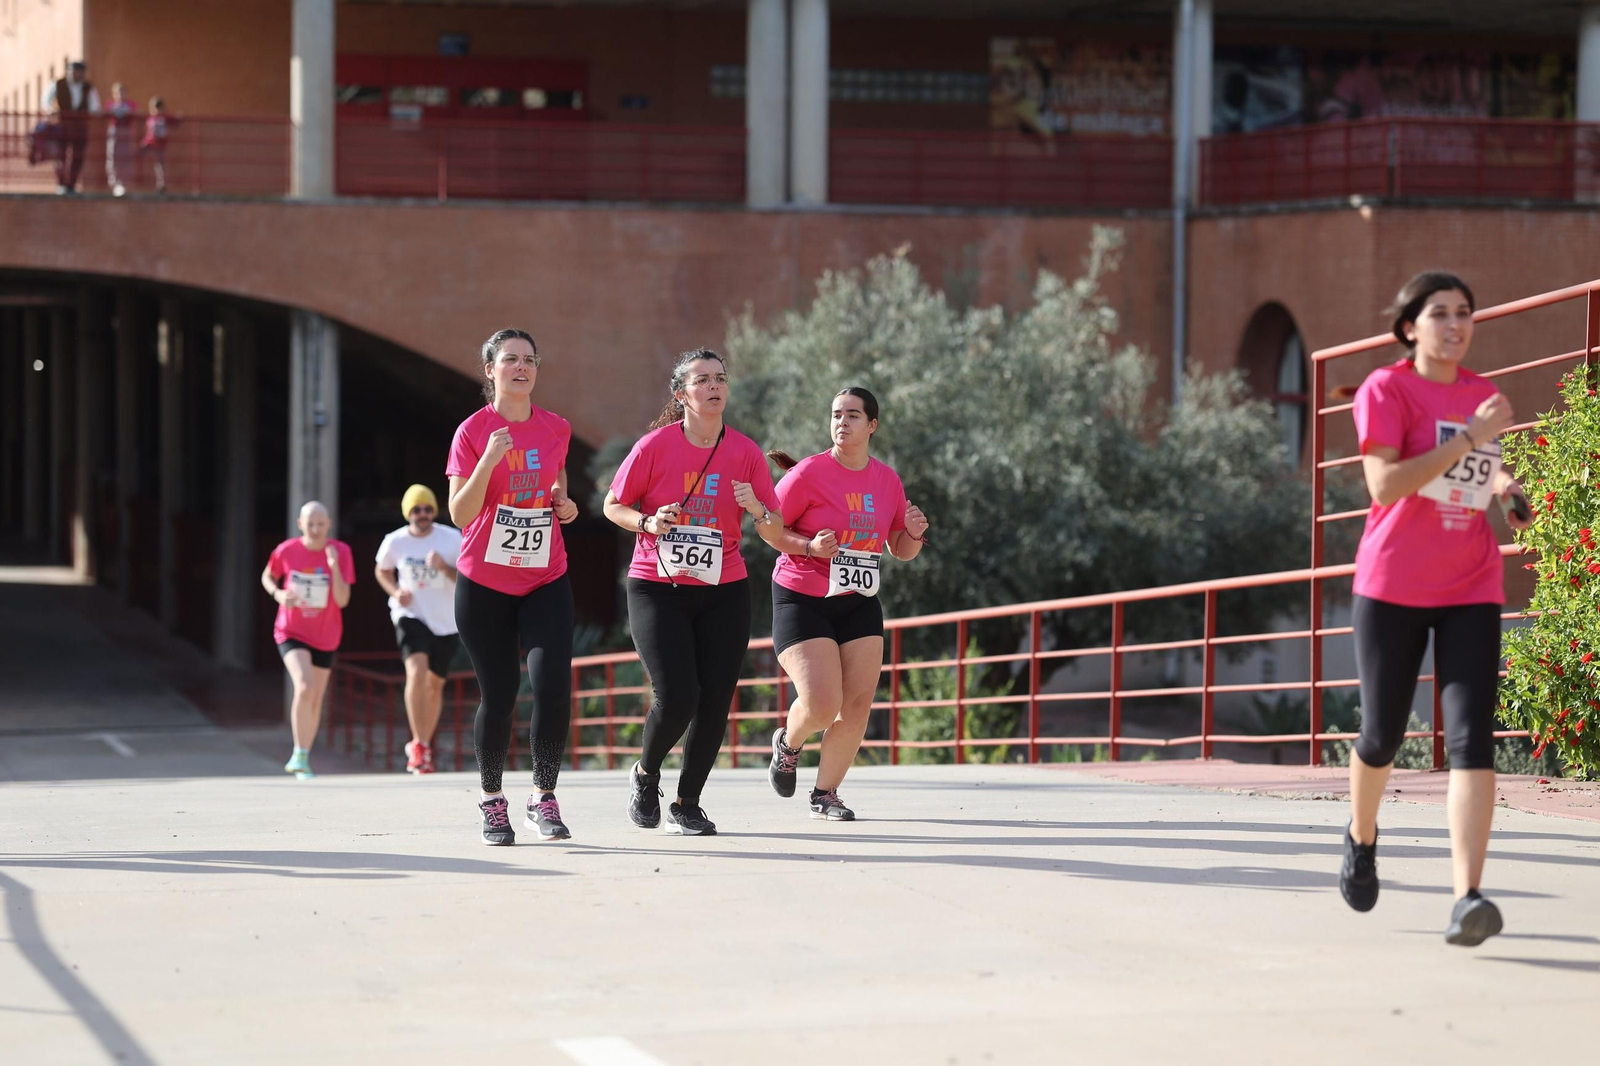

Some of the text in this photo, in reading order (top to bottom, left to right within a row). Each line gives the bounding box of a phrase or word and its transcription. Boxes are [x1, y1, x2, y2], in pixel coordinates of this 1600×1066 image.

[505, 449, 541, 471] WE
[510, 473, 539, 490] RUN
[684, 471, 720, 496] WE
[683, 497, 714, 514] RUN
[845, 493, 875, 512] WE
[499, 515, 527, 527] UMA
[850, 513, 875, 530] RUN
[501, 529, 543, 551] 219
[664, 533, 693, 543] UMA
[670, 544, 714, 569] 564
[834, 556, 855, 566] UMA
[839, 568, 873, 589] 340
